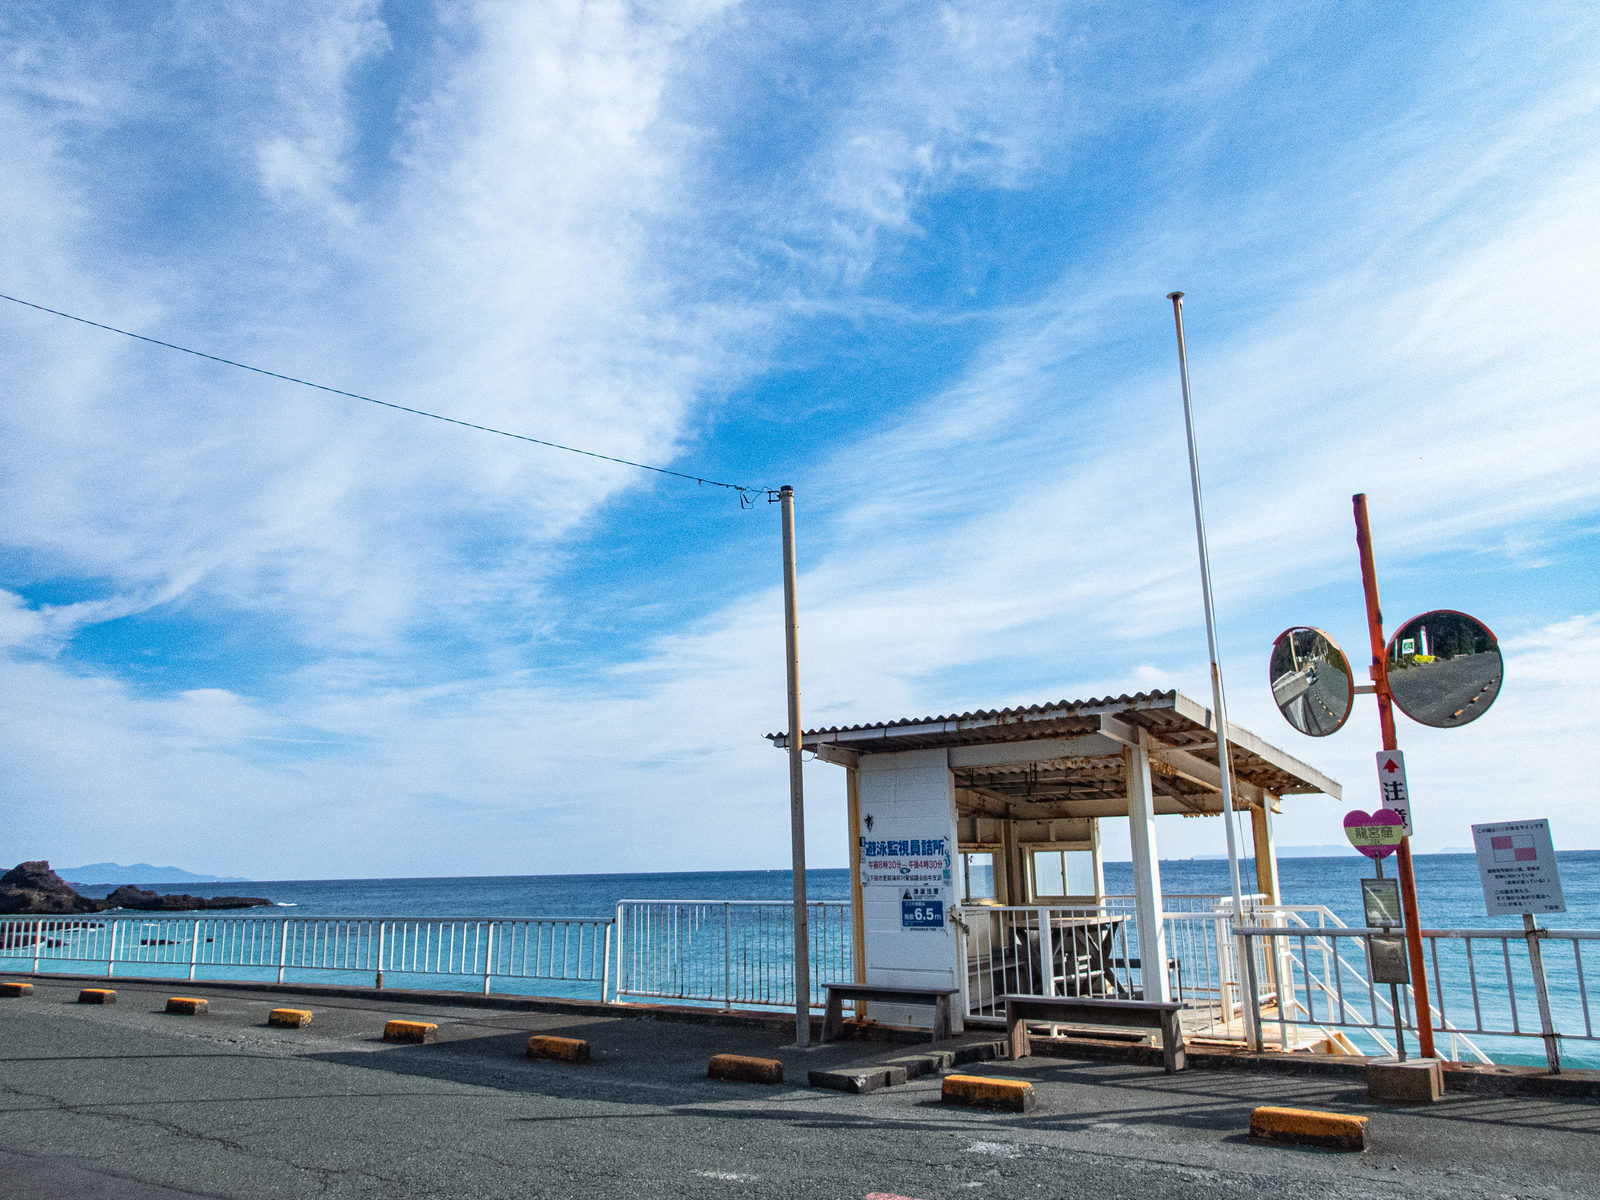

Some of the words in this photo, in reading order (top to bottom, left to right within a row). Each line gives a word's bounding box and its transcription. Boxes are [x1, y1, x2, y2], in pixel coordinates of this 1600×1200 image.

[865, 839, 944, 856] 遊泳監視員詰所
